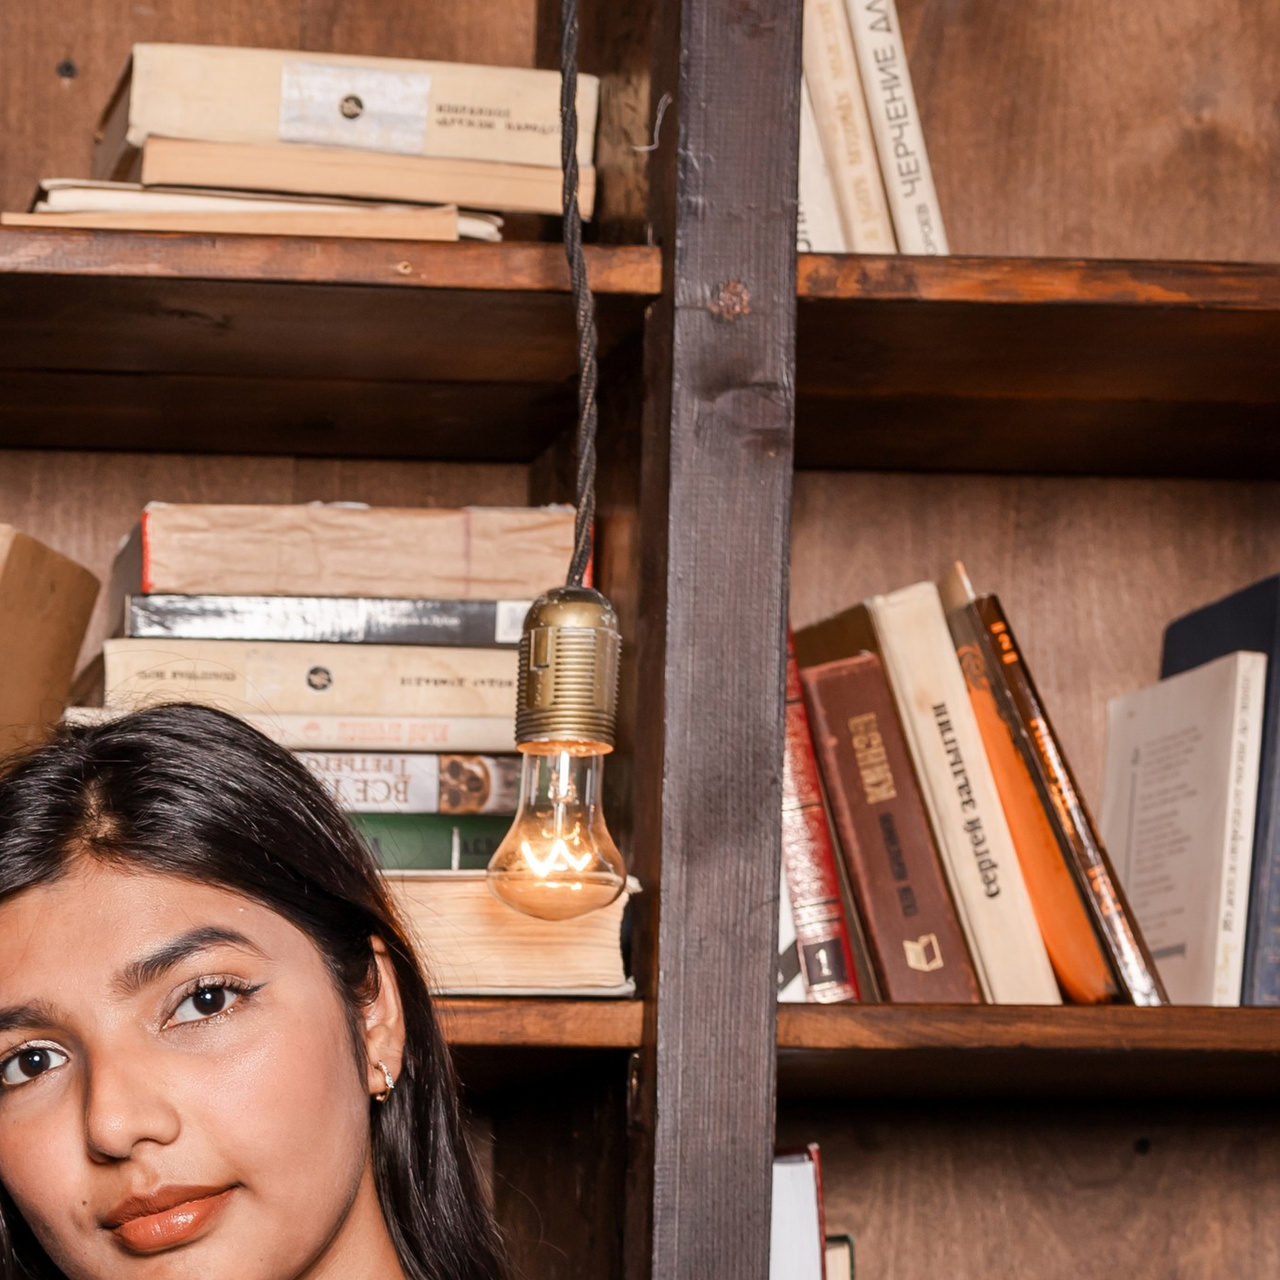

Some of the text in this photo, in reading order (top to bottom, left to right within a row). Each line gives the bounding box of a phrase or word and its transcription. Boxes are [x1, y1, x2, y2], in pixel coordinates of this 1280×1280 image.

[866, 0, 921, 198] ЧЕРЧЕНИЕ ДЛ
[354, 779, 411, 804] ВСЕ
